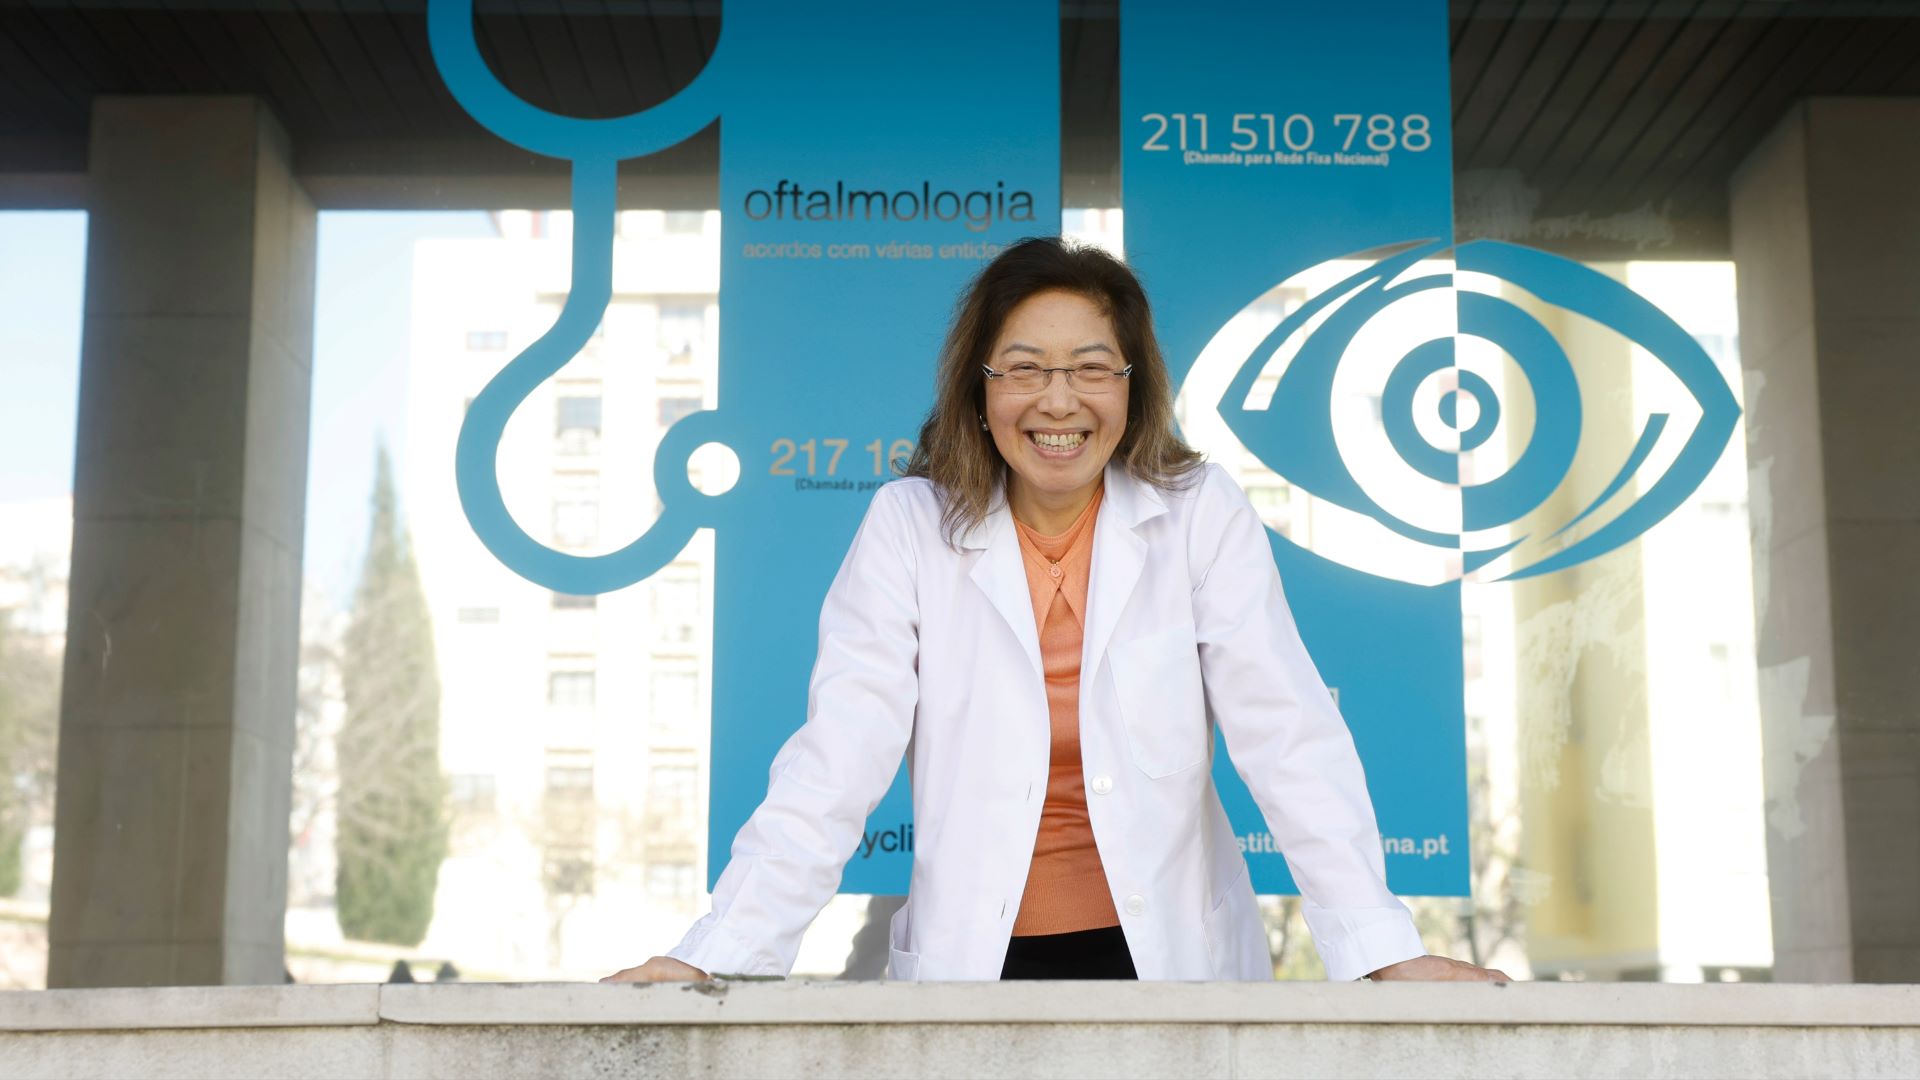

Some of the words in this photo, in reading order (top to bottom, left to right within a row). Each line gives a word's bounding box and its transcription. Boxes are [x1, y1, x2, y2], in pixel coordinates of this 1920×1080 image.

[1141, 113, 1207, 151] 211
[1231, 114, 1314, 151] 510
[1334, 113, 1431, 151] 788
[1184, 151, 1242, 165] (Chamada
[1245, 154, 1272, 166] para
[1275, 152, 1304, 165] Rede
[1307, 152, 1331, 165] Fixa
[1334, 153, 1389, 167] Nacional)
[744, 179, 1036, 233] oftalmologia
[743, 242, 822, 259] acordos
[828, 245, 870, 259] com
[877, 240, 933, 259] várias
[769, 438, 848, 476] 217
[795, 478, 854, 492] (Chamada
[857, 824, 913, 859] ycli
